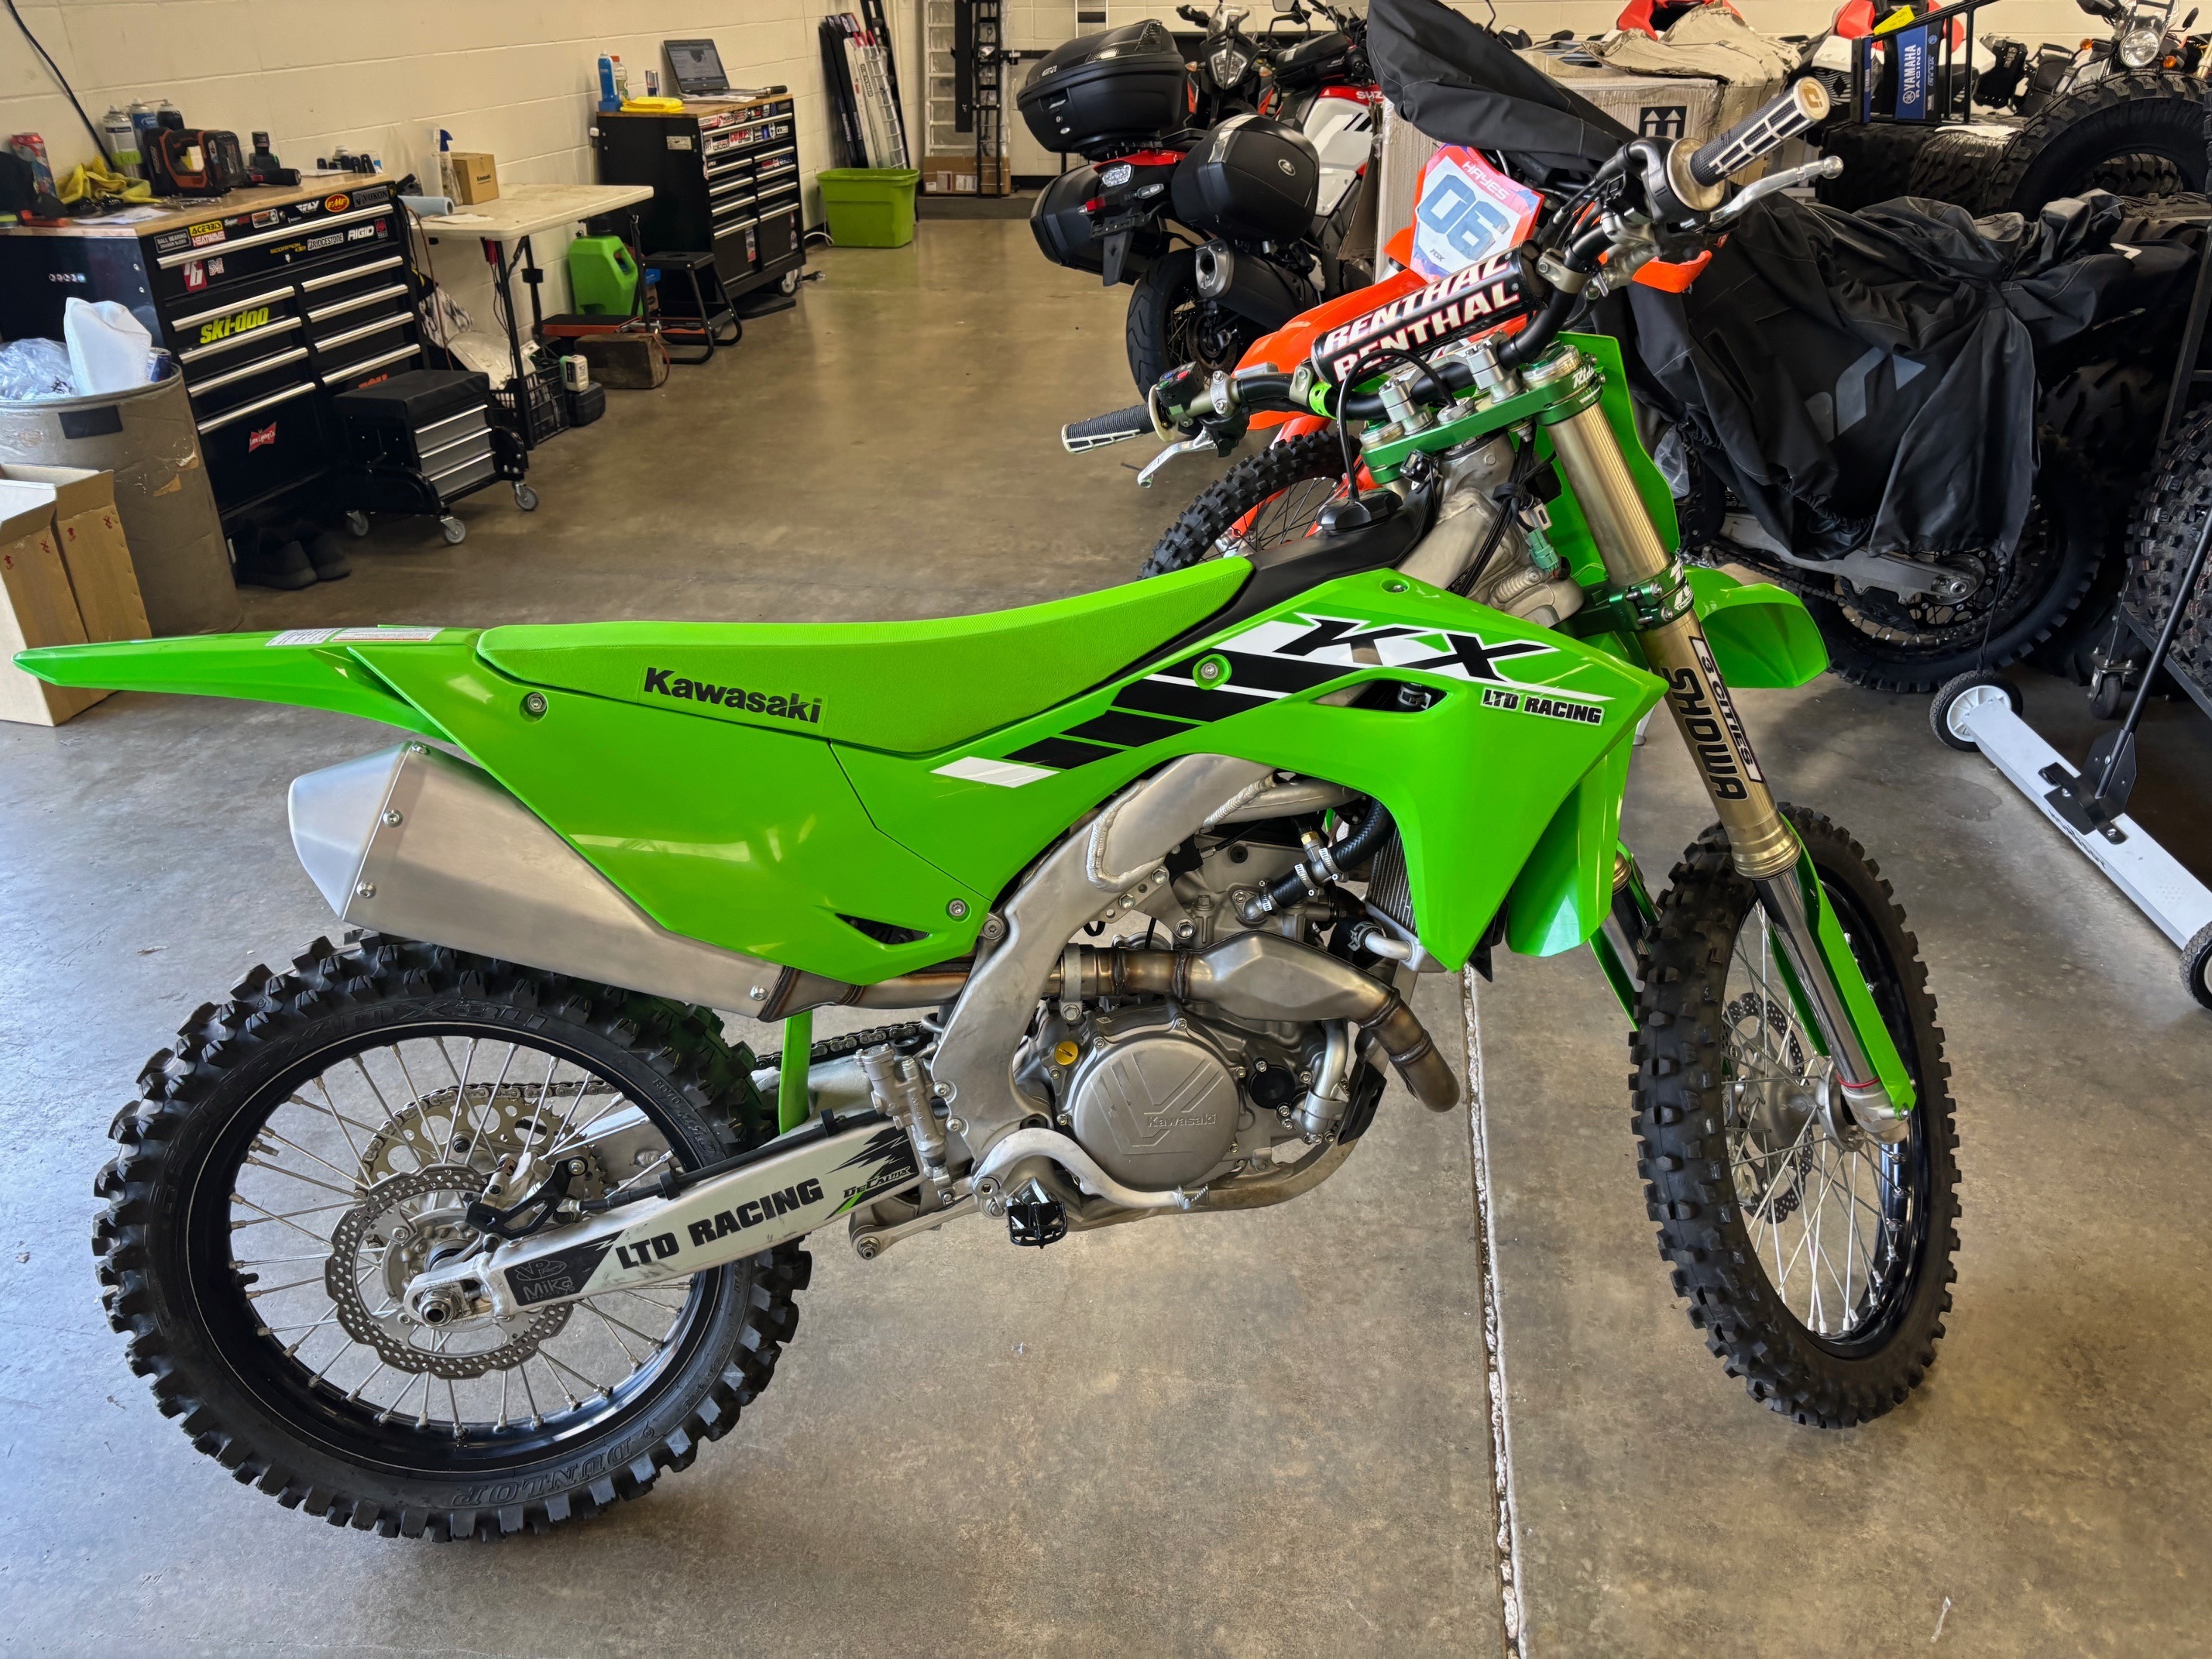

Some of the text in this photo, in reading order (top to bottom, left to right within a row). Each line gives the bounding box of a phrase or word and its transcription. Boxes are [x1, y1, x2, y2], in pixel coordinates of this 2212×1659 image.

[1904, 44, 1916, 91] YAMAHA
[1356, 91, 1385, 102] SUZ
[363, 191, 386, 202] YUKON
[1462, 161, 1509, 200] HAYES
[328, 198, 346, 208] FMF
[1418, 174, 1510, 261] 06
[192, 223, 222, 234] ACERBIS
[308, 234, 342, 250] BRIDGESTONE
[349, 225, 374, 241] RIGID
[200, 307, 269, 343] ski-doo
[1323, 252, 1510, 356] RENTHAL
[1333, 281, 1520, 383] RENTHAL
[1273, 615, 1554, 683] KX
[644, 667, 823, 723] Kawasaki
[1484, 689, 1602, 724] LTD RACING
[1701, 655, 1753, 765] 3 CITIES
[1661, 667, 1748, 800] SHOWA
[1148, 1114, 1216, 1127] Kawasaki
[616, 1177, 825, 1269] LTD RACING
[452, 1435, 635, 1506] DUNLOP
